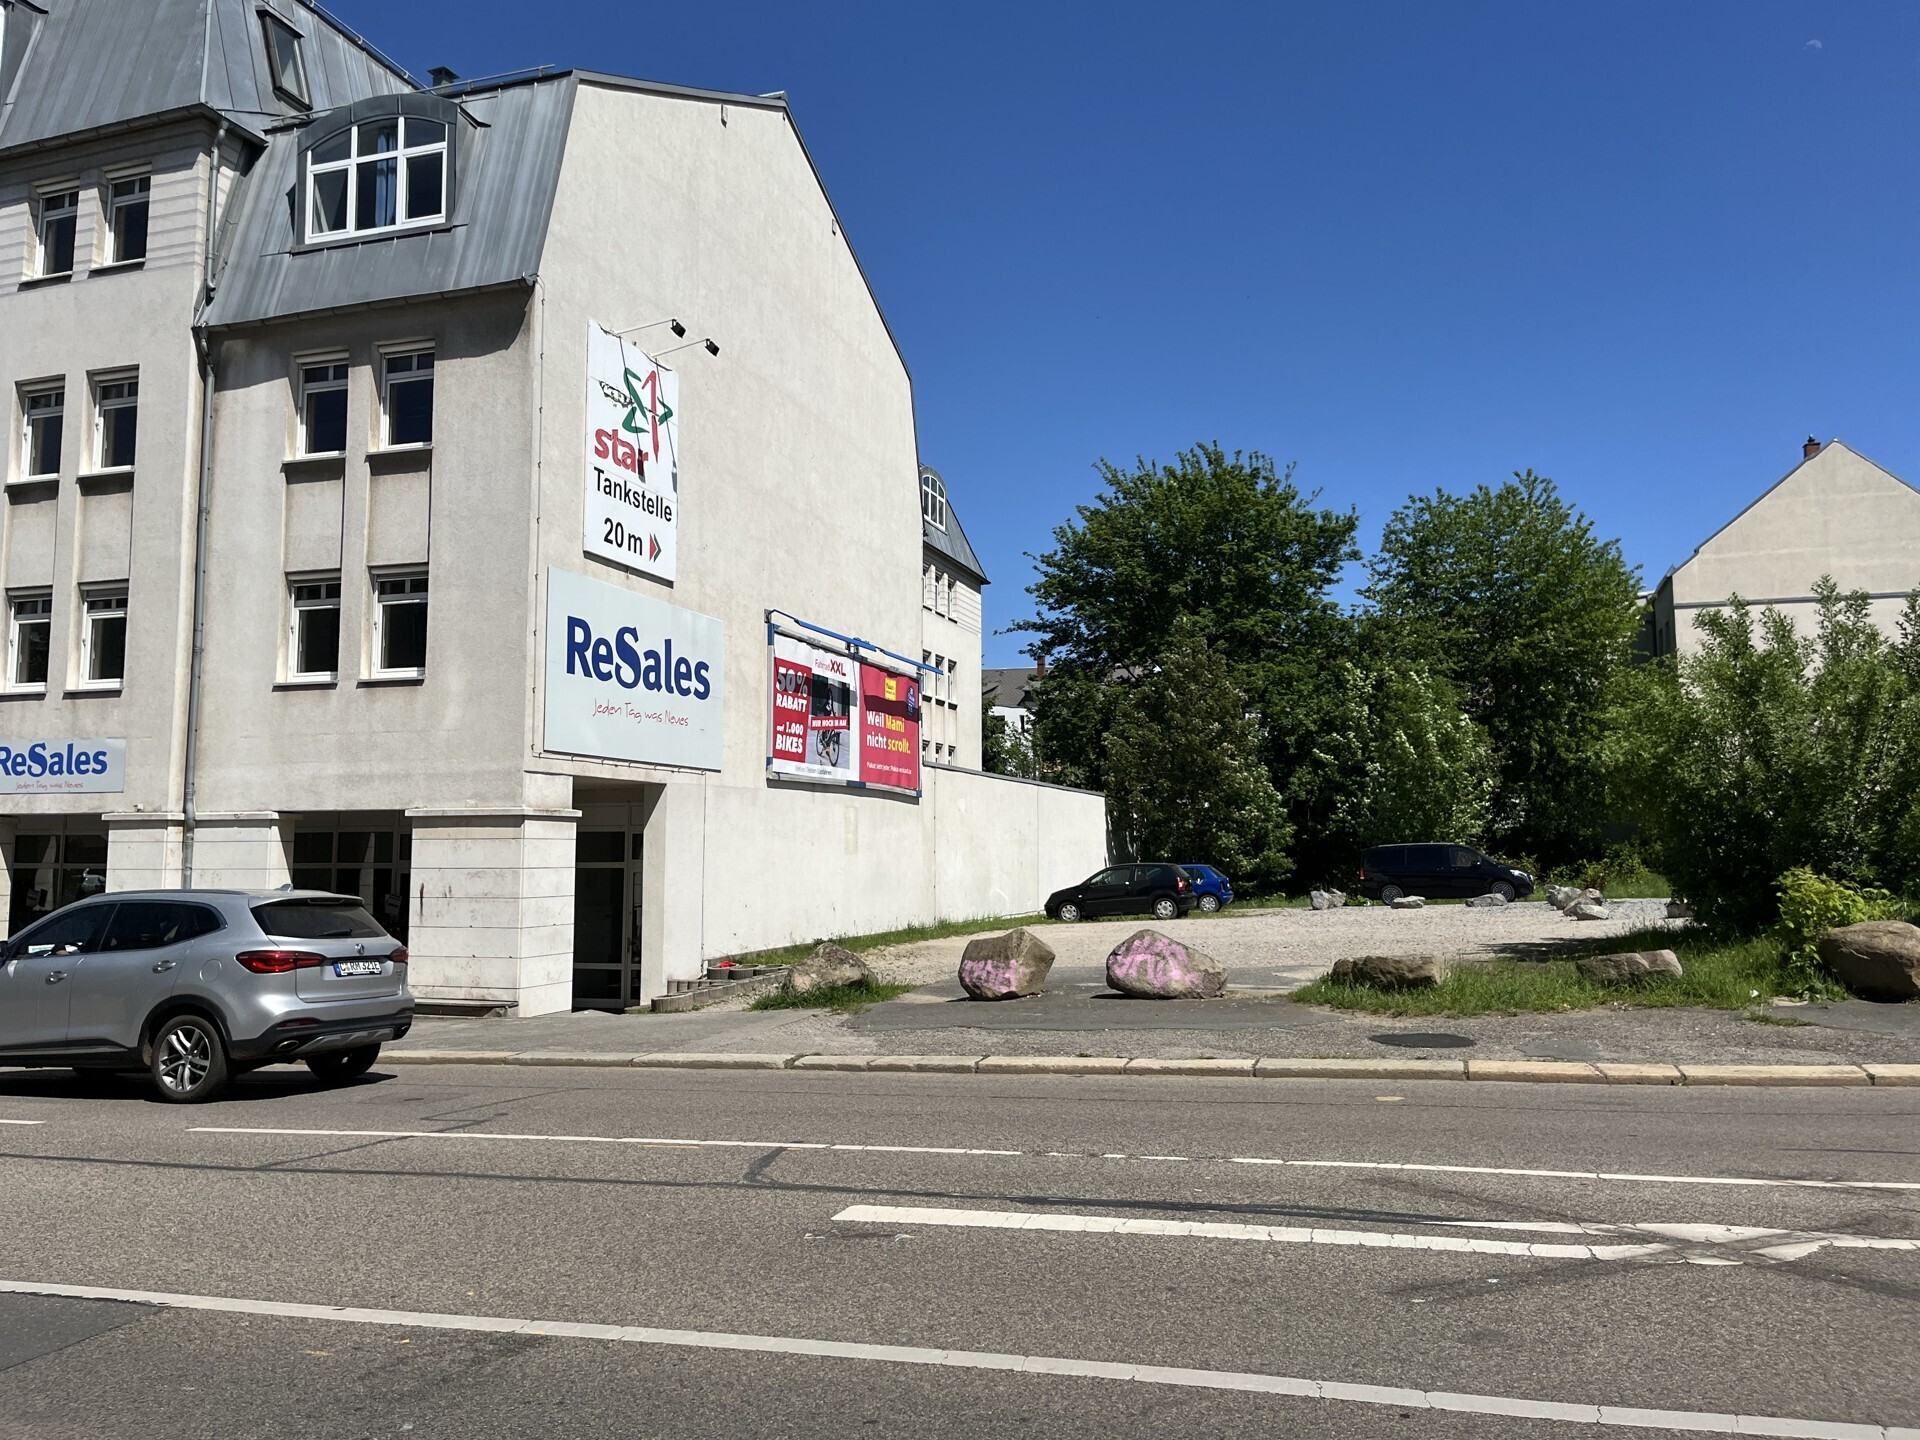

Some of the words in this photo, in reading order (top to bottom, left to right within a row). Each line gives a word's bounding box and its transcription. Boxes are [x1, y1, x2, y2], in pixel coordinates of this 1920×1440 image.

[594, 428, 649, 477] star
[594, 466, 672, 522] Tankstelle
[603, 517, 624, 548] 20
[627, 532, 643, 556] m
[566, 615, 711, 701] ReSales
[592, 698, 622, 717] Jeden
[625, 702, 642, 724] Tag
[645, 711, 663, 723] was
[665, 709, 689, 727] Neues
[776, 693, 807, 713] RABATT
[776, 724, 785, 732] auf
[786, 722, 804, 735] 1.000
[866, 710, 885, 728] Weil
[886, 715, 905, 733] Mami
[776, 734, 803, 753] BIKES
[866, 732, 887, 749] nicht
[887, 738, 911, 754] scrollt.
[0, 742, 108, 778] ReSales
[16, 781, 34, 791] Jeden
[36, 781, 48, 791] Tag
[64, 780, 84, 789] Neues
